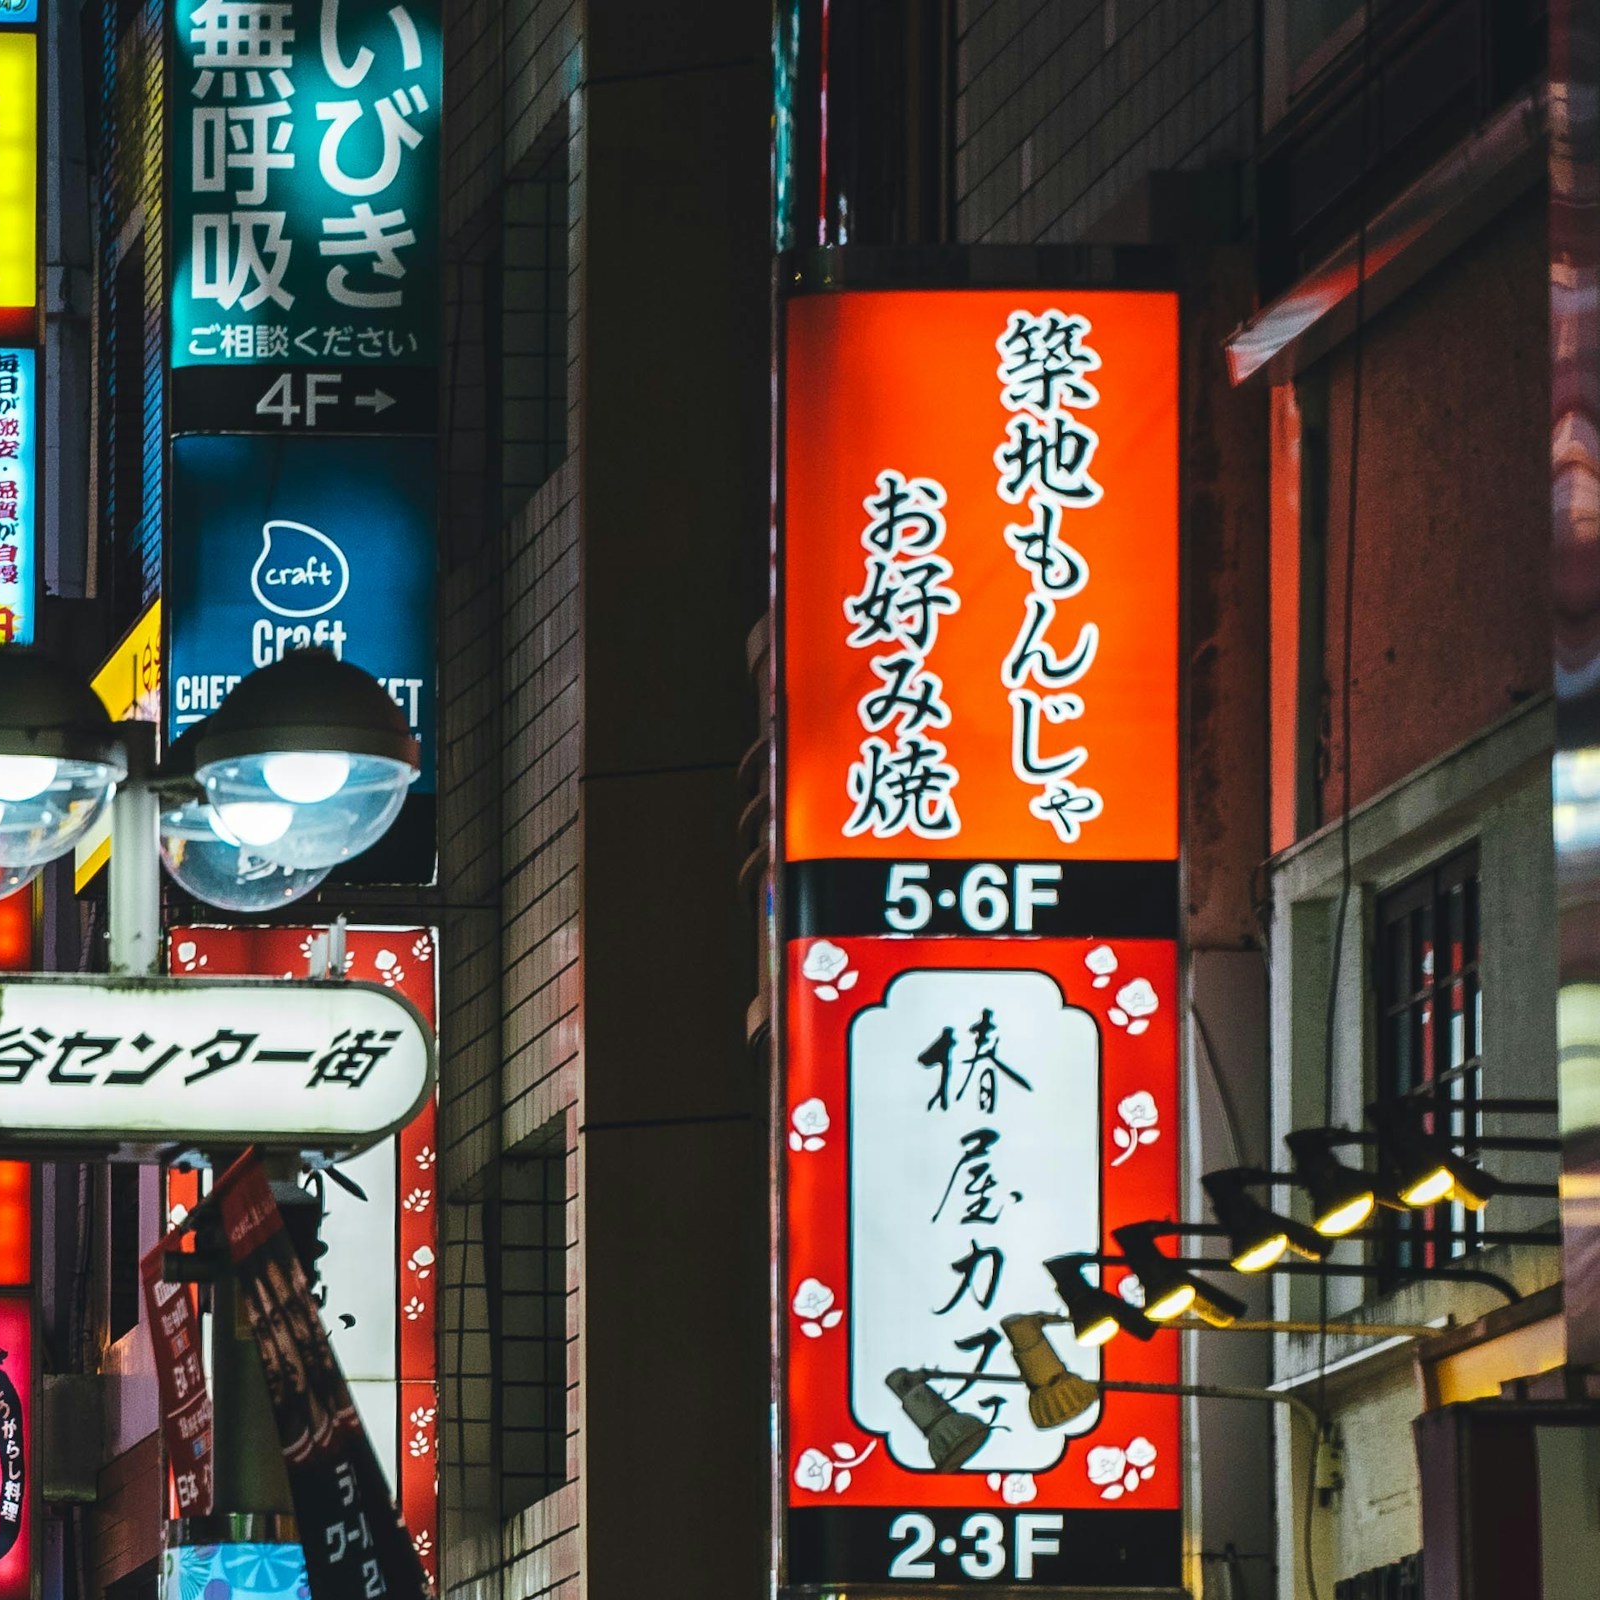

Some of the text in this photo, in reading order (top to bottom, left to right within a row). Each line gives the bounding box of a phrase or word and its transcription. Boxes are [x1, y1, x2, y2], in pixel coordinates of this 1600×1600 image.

[189, 0, 296, 312] 無呼吸
[315, 0, 430, 308] いびき
[187, 322, 419, 358] ご相談ください
[255, 372, 342, 426] 4F
[252, 619, 349, 669] Craft
[265, 560, 333, 590] craft
[846, 472, 959, 836] お好み焼
[999, 312, 1101, 840] 築地もんじゃ
